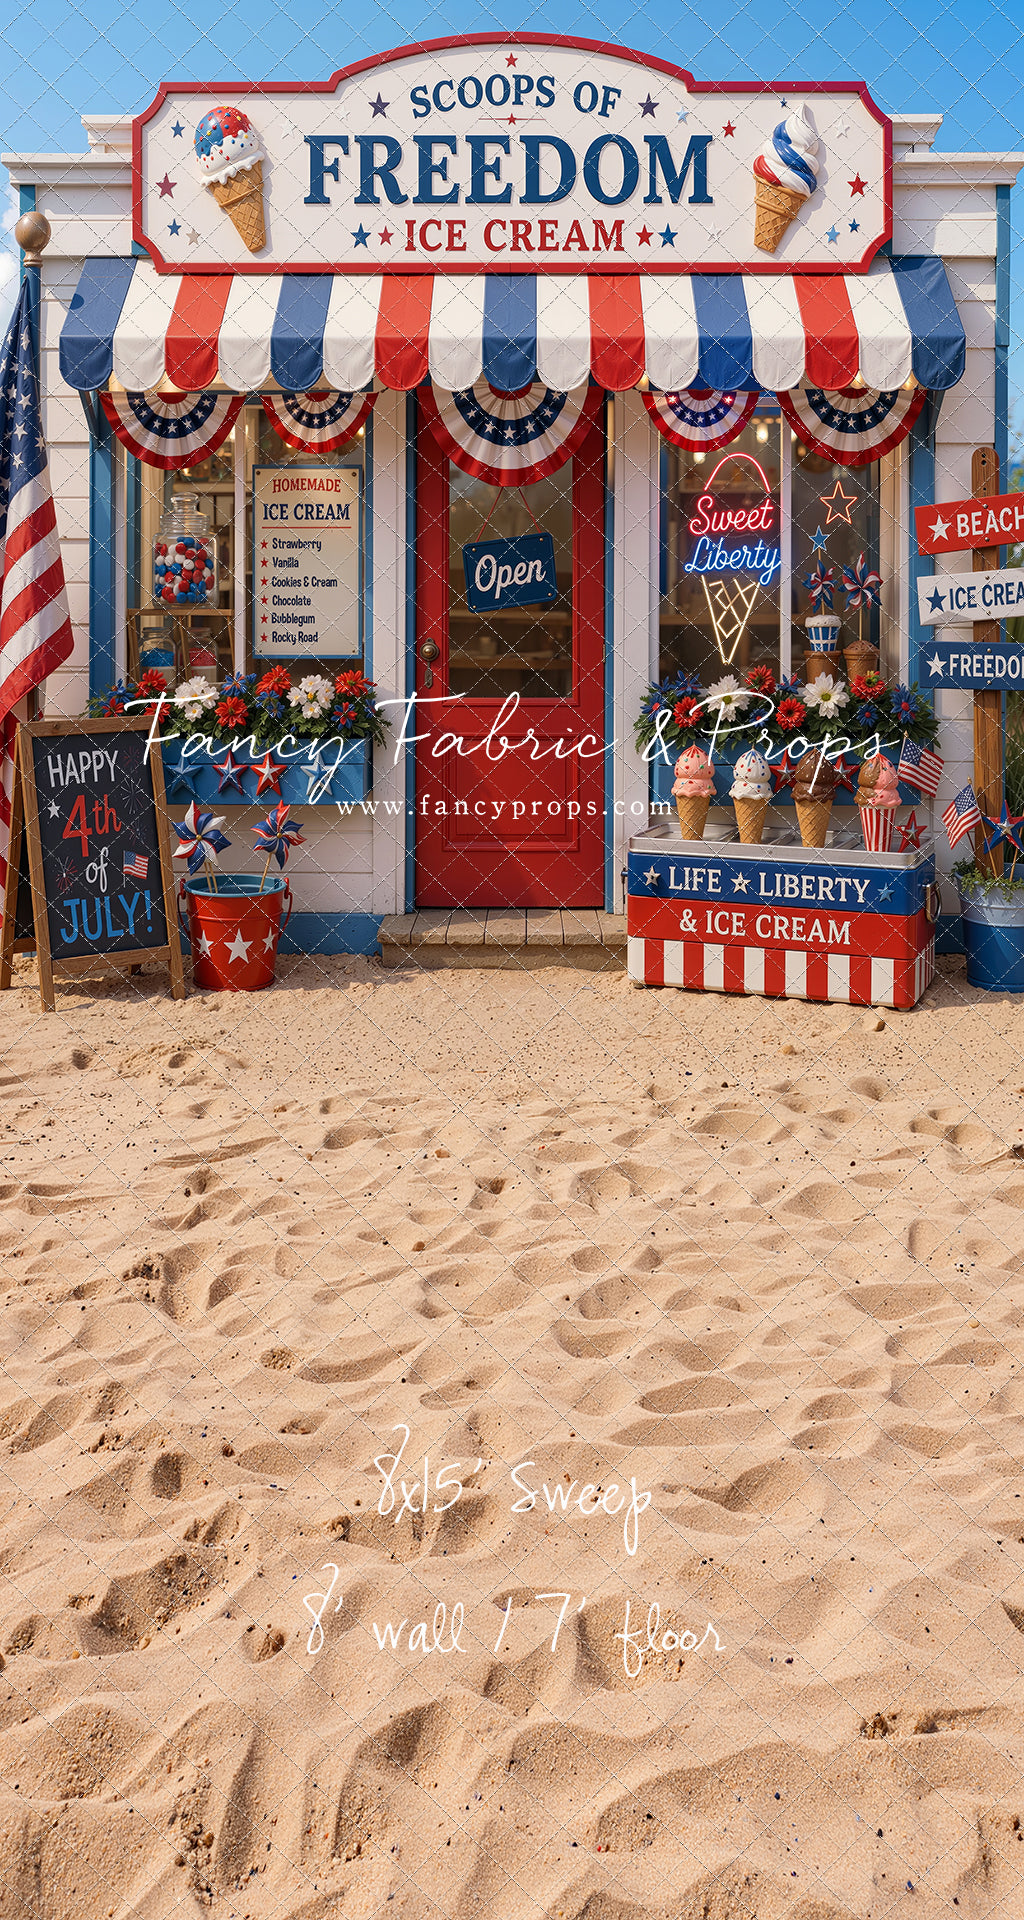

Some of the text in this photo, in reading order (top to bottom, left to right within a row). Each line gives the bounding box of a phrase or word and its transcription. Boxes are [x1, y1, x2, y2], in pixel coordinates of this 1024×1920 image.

[409, 73, 622, 119] SCOOPS OF
[303, 133, 714, 206] FREEDOM
[404, 219, 625, 252] ICE CREAM
[272, 478, 341, 494] HOMEMADE
[263, 503, 351, 521] ICE CREAM
[689, 495, 774, 535] Sweet
[956, 506, 1024, 538] BEACH
[272, 538, 322, 552] Strawberry
[684, 536, 782, 586] Liberty
[272, 557, 299, 568] Vanilla
[474, 554, 547, 600] Open
[271, 576, 338, 587] Cookies & Cream
[949, 586, 977, 610] ICE
[272, 594, 312, 607] Chocolate
[271, 613, 316, 627] Bubblegum
[272, 632, 318, 646] Rocky Road
[949, 654, 1024, 679] FREEDO
[47, 750, 119, 788] HAPPY
[62, 794, 122, 858] 4th
[85, 847, 110, 893] of
[668, 866, 871, 904] LIFE LIBERTY
[60, 889, 153, 944] JULY!
[679, 908, 851, 946] & ICE CREAM
